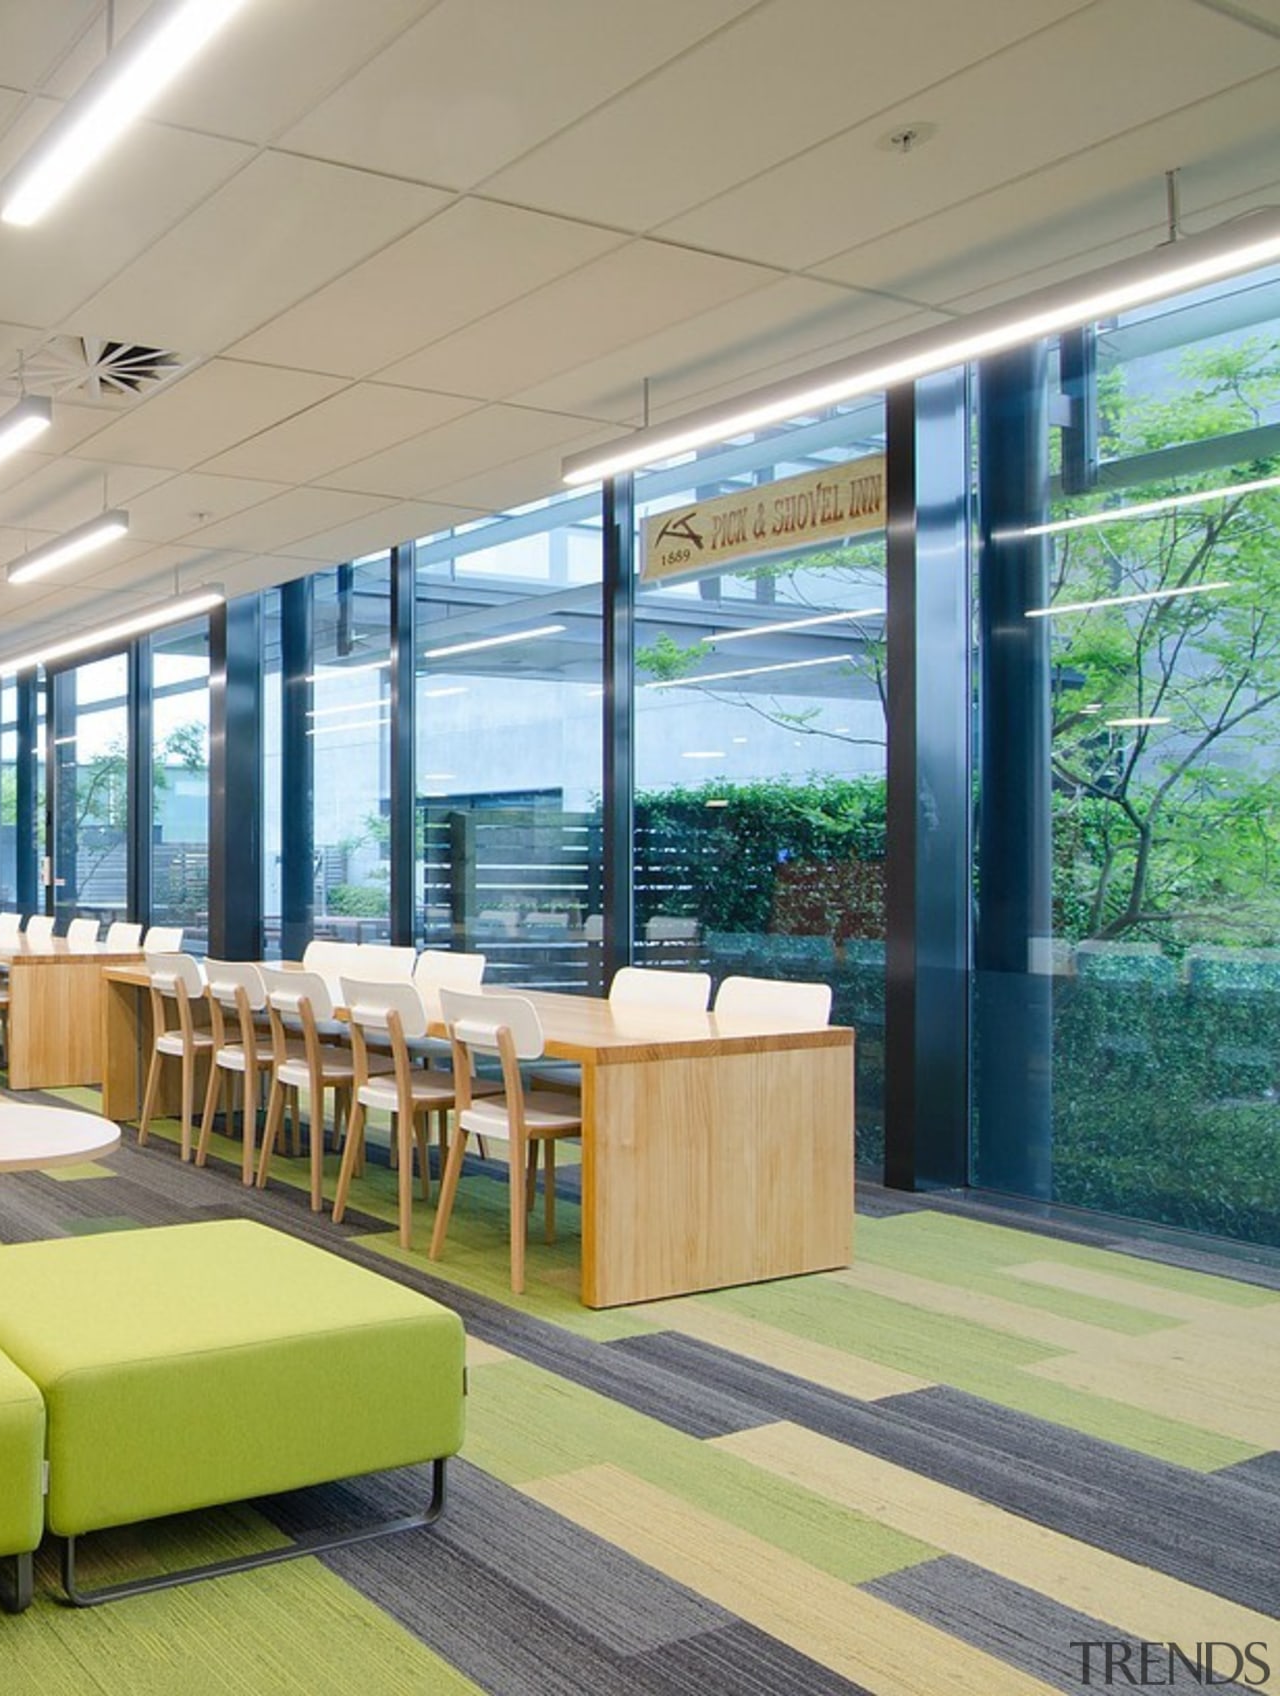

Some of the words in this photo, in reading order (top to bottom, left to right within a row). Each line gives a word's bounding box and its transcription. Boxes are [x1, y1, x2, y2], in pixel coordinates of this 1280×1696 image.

[711, 506, 748, 550] PICK
[753, 501, 766, 539] &
[772, 482, 843, 535] SHOVEL
[848, 474, 882, 517] INN
